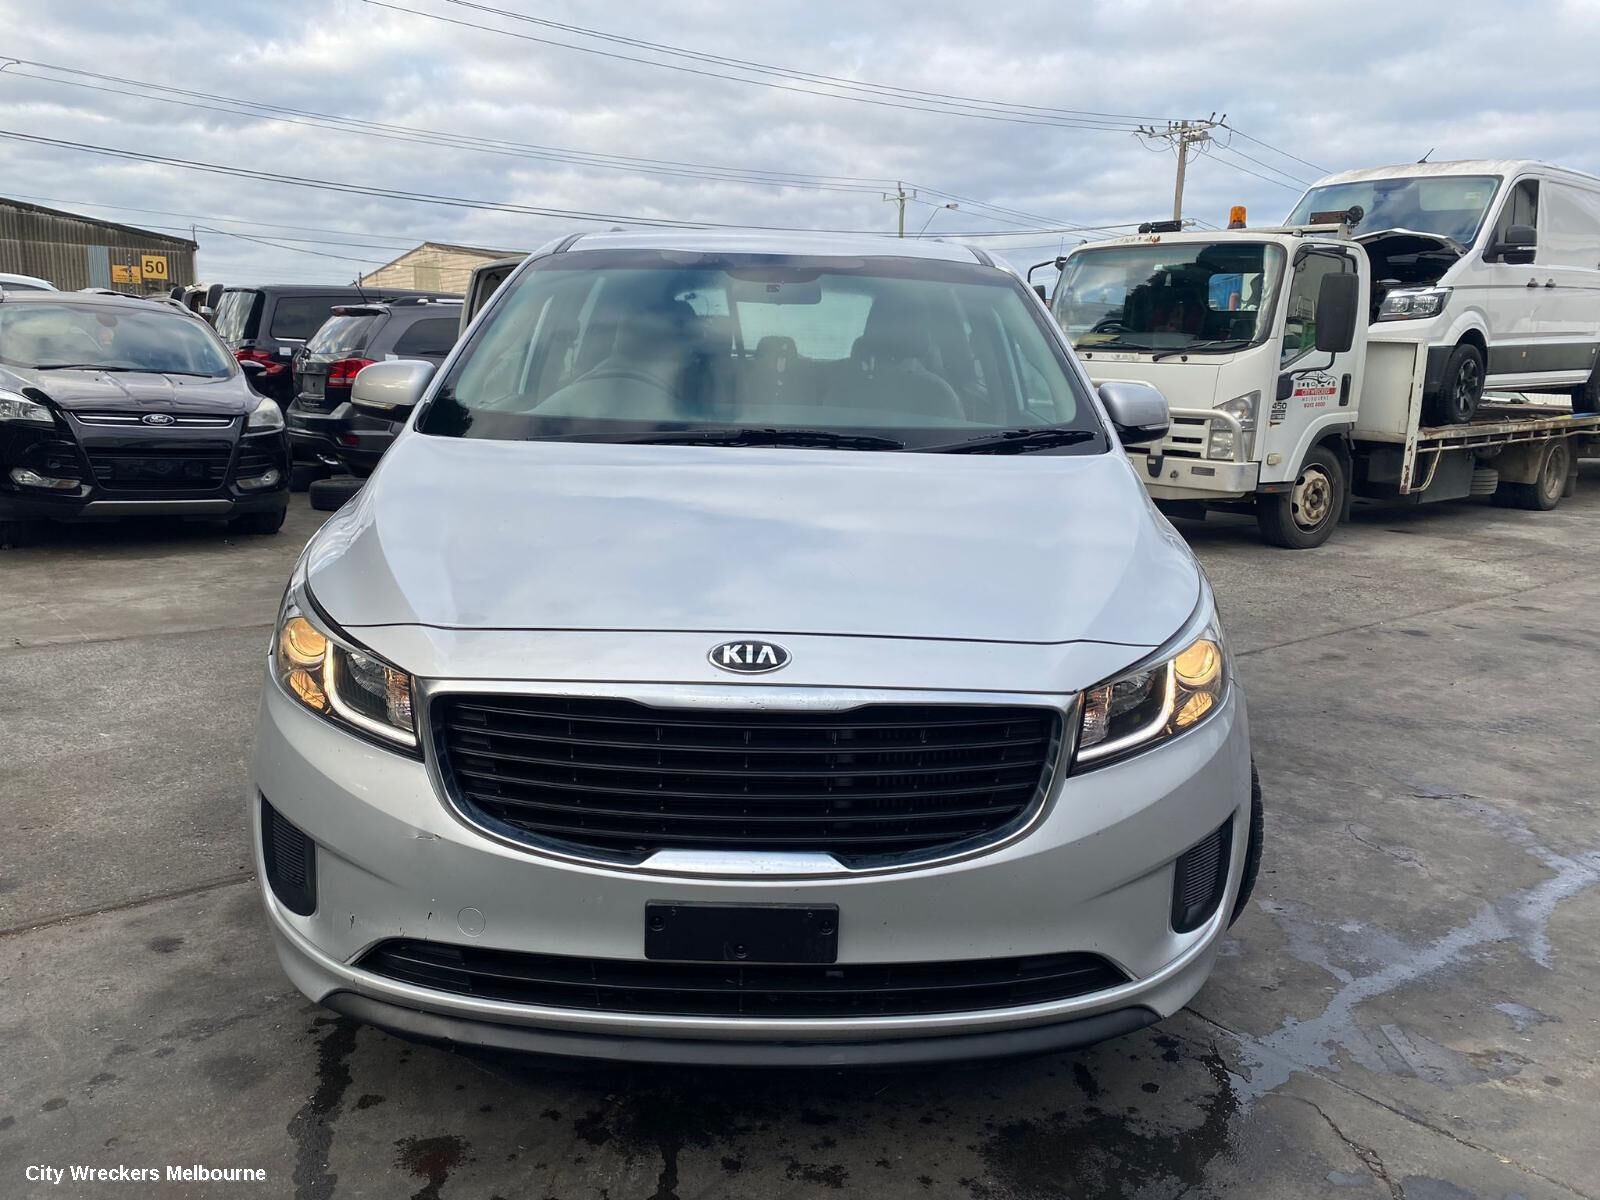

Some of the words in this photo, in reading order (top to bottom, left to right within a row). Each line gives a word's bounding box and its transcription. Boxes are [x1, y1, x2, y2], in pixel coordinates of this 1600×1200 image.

[145, 260, 165, 274] 50
[1272, 402, 1287, 410] 450
[150, 415, 168, 423] Ford
[723, 644, 778, 665] KIA
